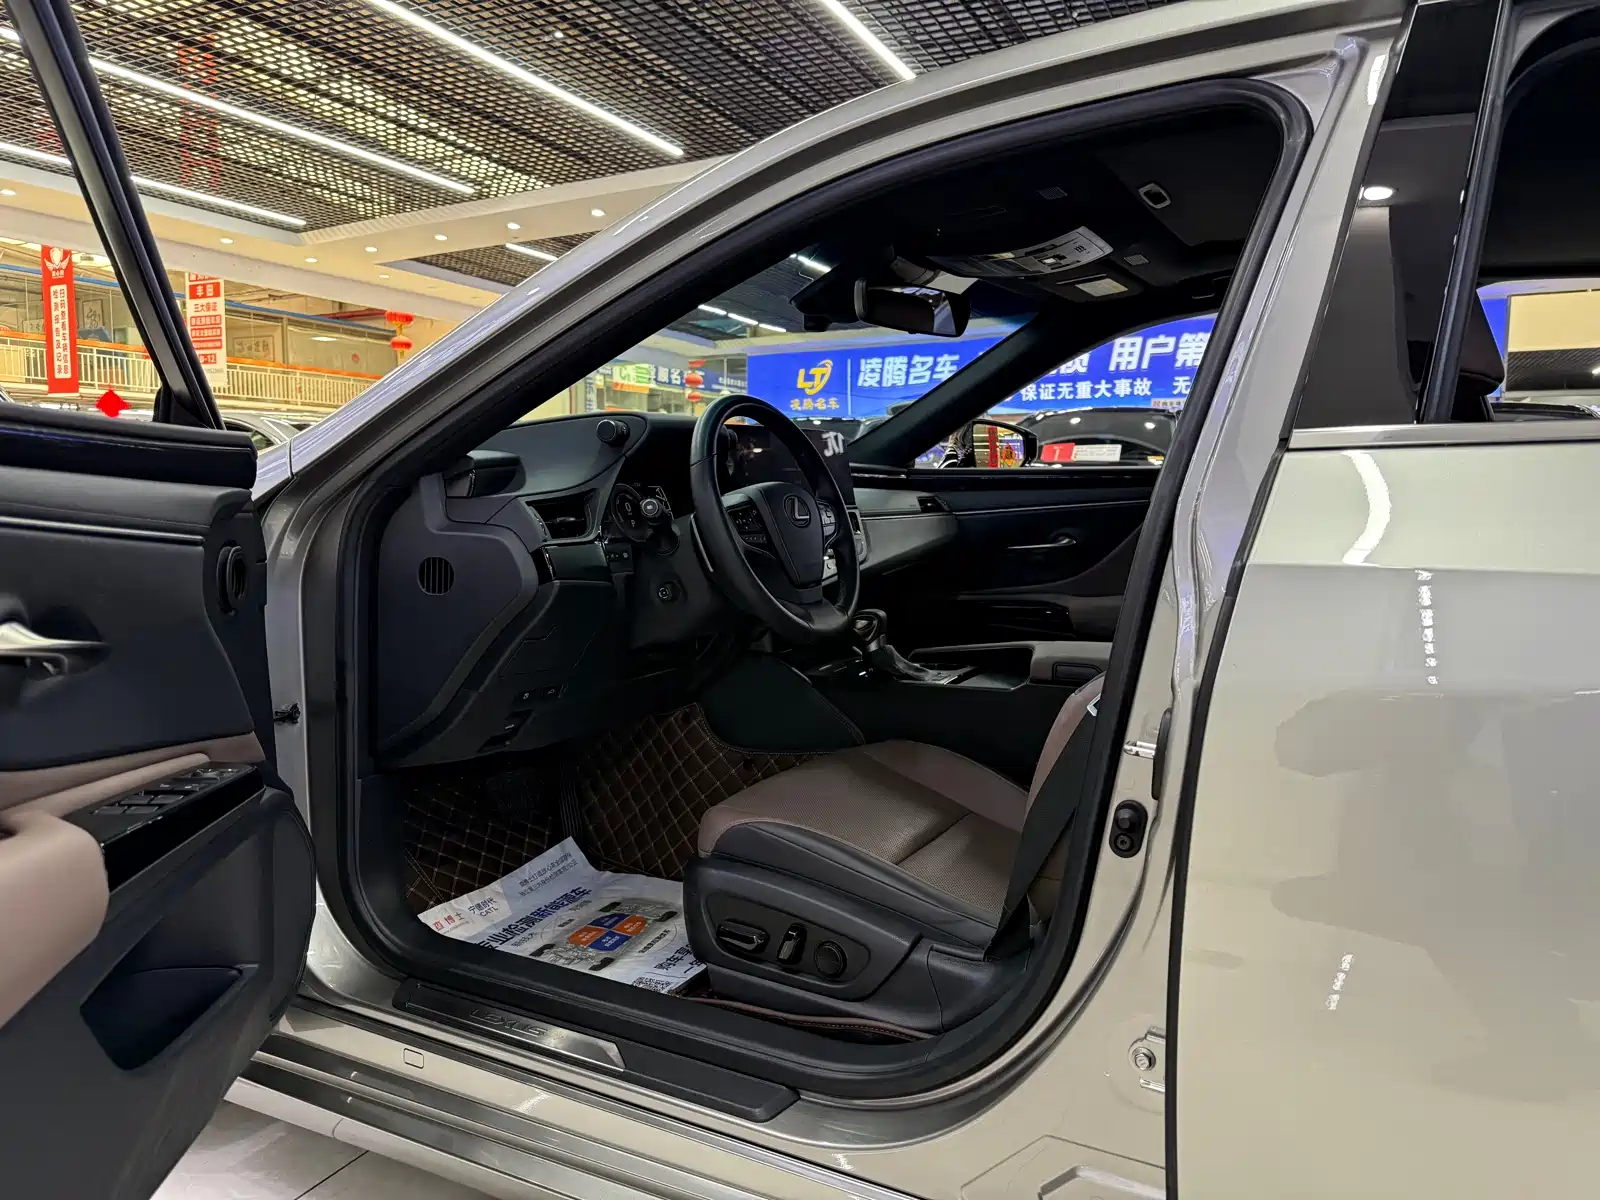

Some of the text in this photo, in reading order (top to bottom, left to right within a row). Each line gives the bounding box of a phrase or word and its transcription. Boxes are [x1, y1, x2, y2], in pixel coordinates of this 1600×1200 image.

[857, 354, 960, 387] 凌腾名车
[1020, 377, 1152, 402] 保证无重大事故
[480, 907, 499, 917] CATL
